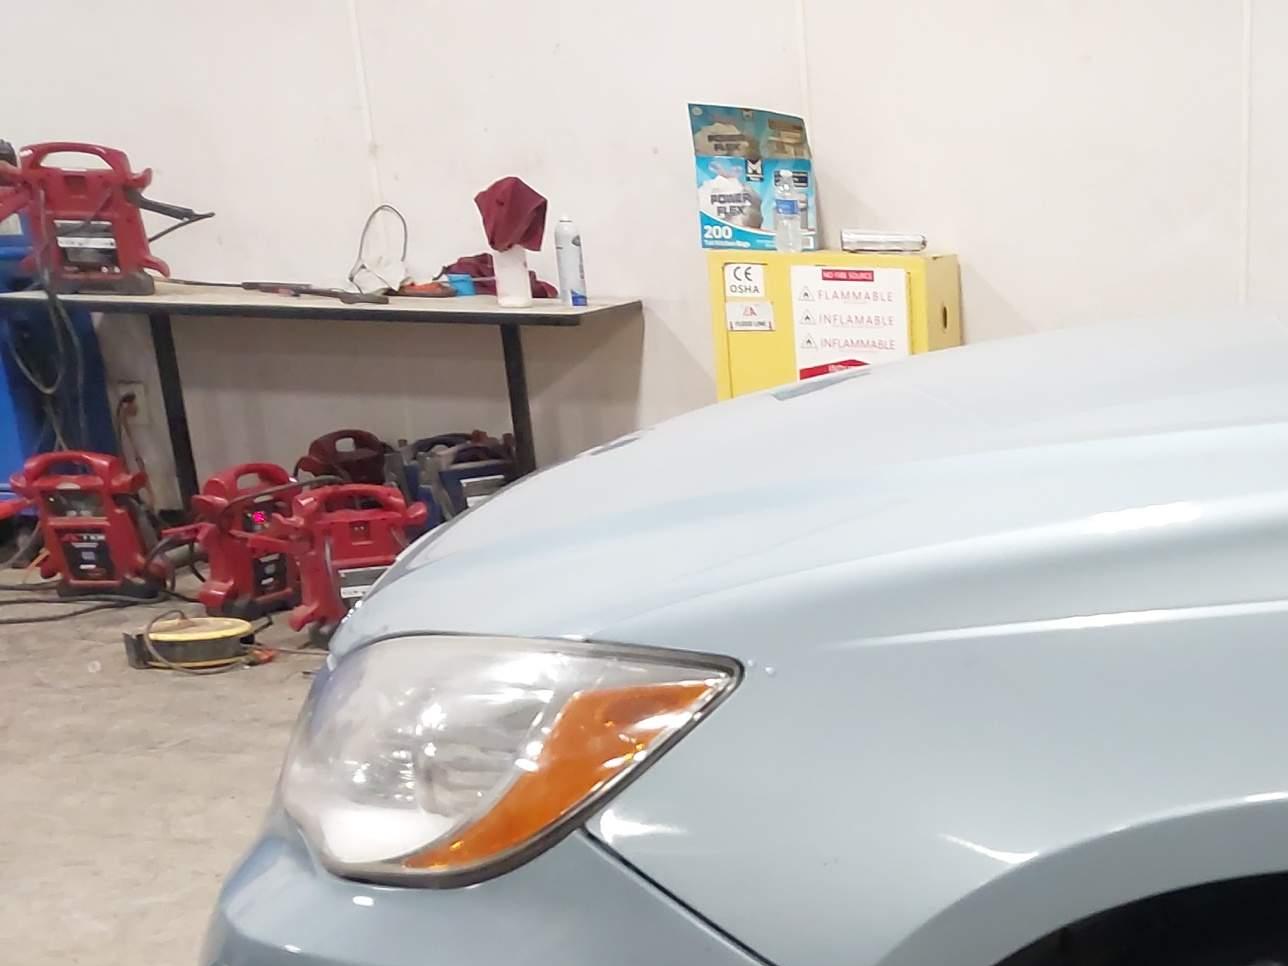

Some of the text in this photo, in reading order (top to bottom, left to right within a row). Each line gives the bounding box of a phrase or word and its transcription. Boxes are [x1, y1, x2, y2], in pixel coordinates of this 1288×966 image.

[710, 192, 752, 205] POWER
[717, 206, 745, 217] FLEX
[703, 225, 733, 239] 200
[733, 266, 753, 281] CE
[730, 284, 760, 294] OSHA
[817, 289, 893, 302] FLAMMABLE
[819, 313, 895, 326] INFLAMABLE
[820, 337, 896, 350] INFLAMMABLE
